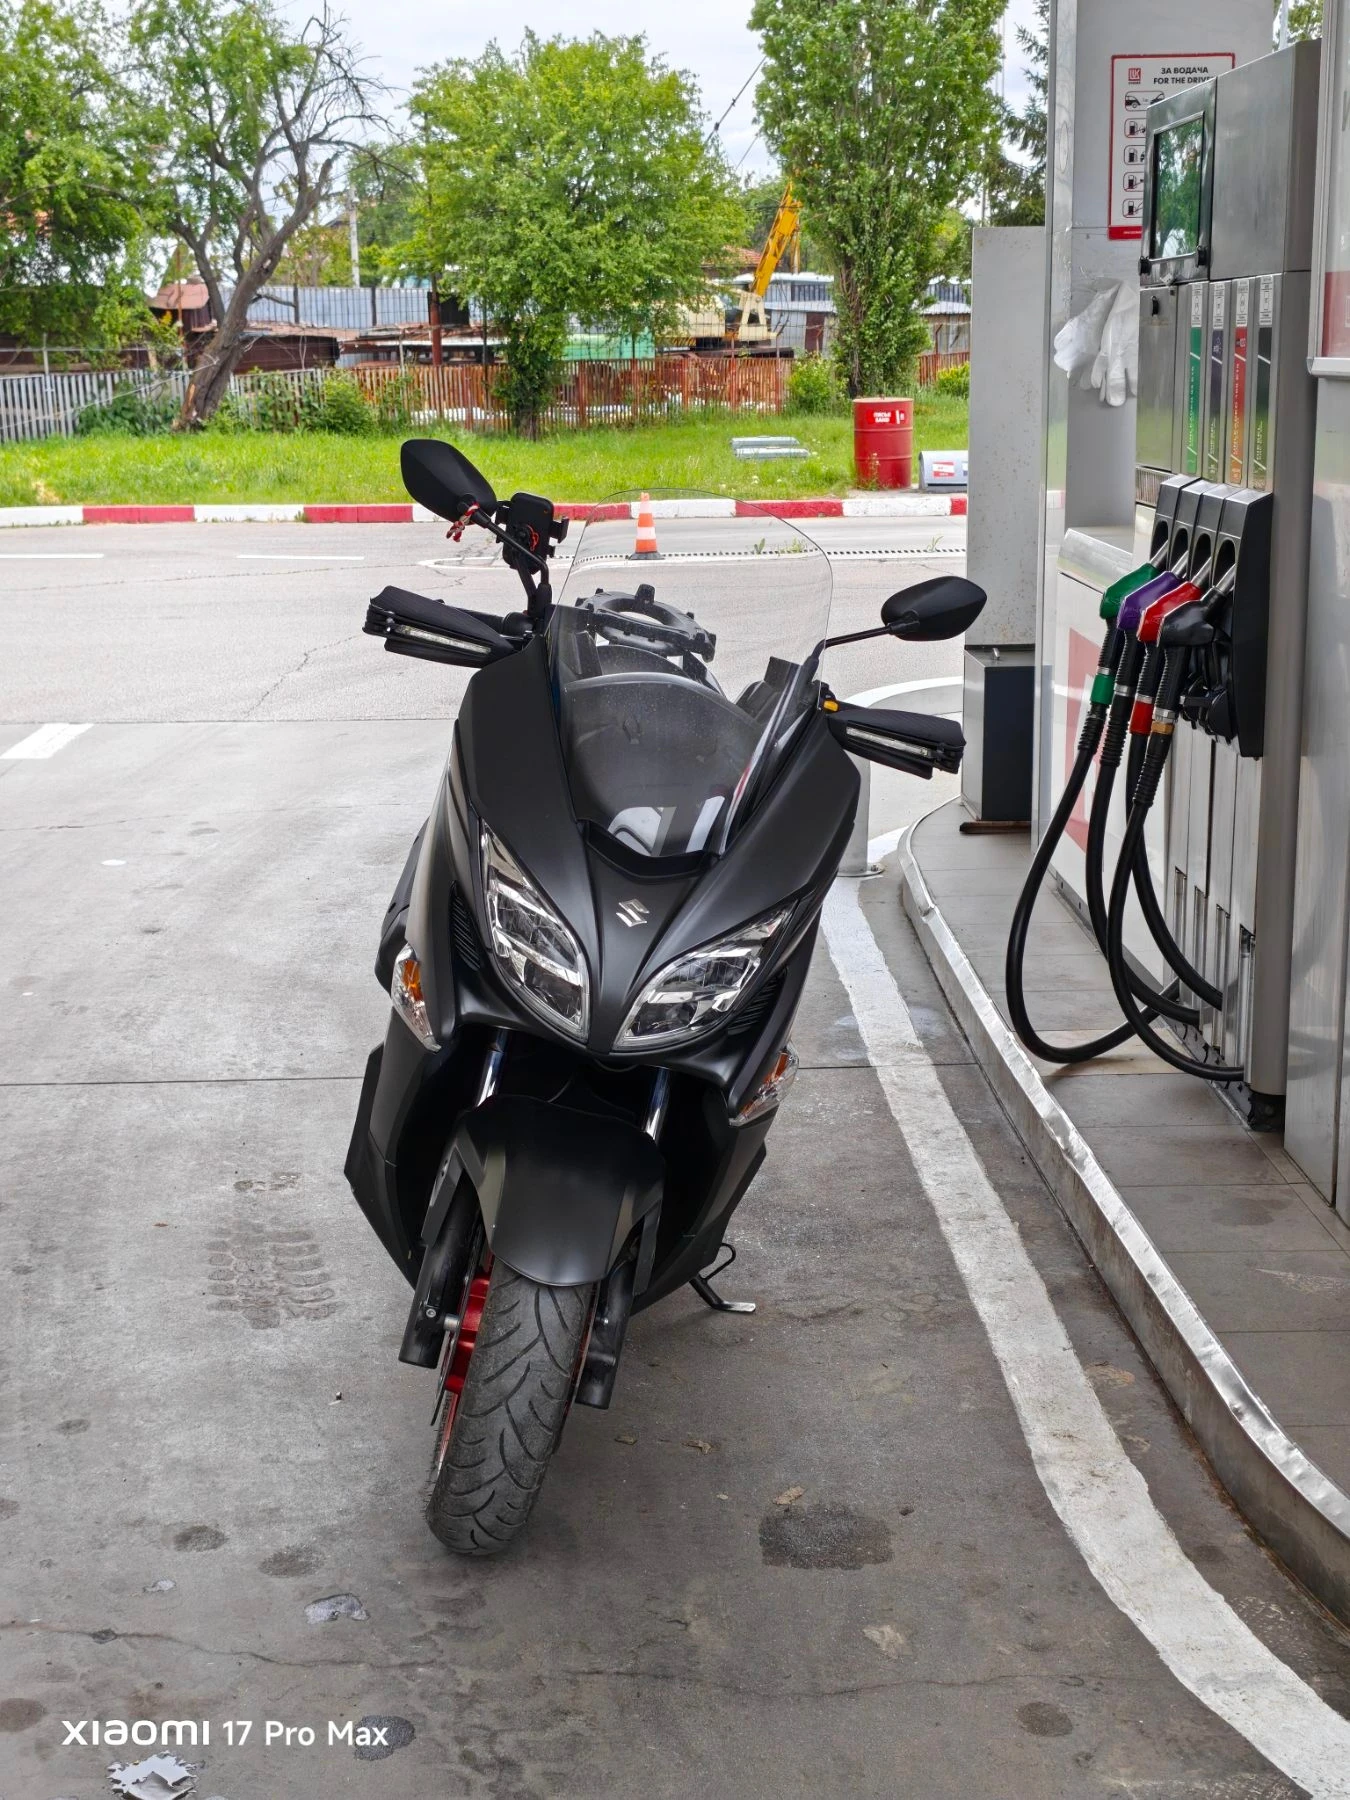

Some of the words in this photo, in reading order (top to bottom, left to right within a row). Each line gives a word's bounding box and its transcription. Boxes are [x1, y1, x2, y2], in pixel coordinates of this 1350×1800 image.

[1161, 67, 1172, 75] ЗА
[1173, 66, 1209, 75] ВОДАЧА
[1153, 77, 1169, 85] FOR
